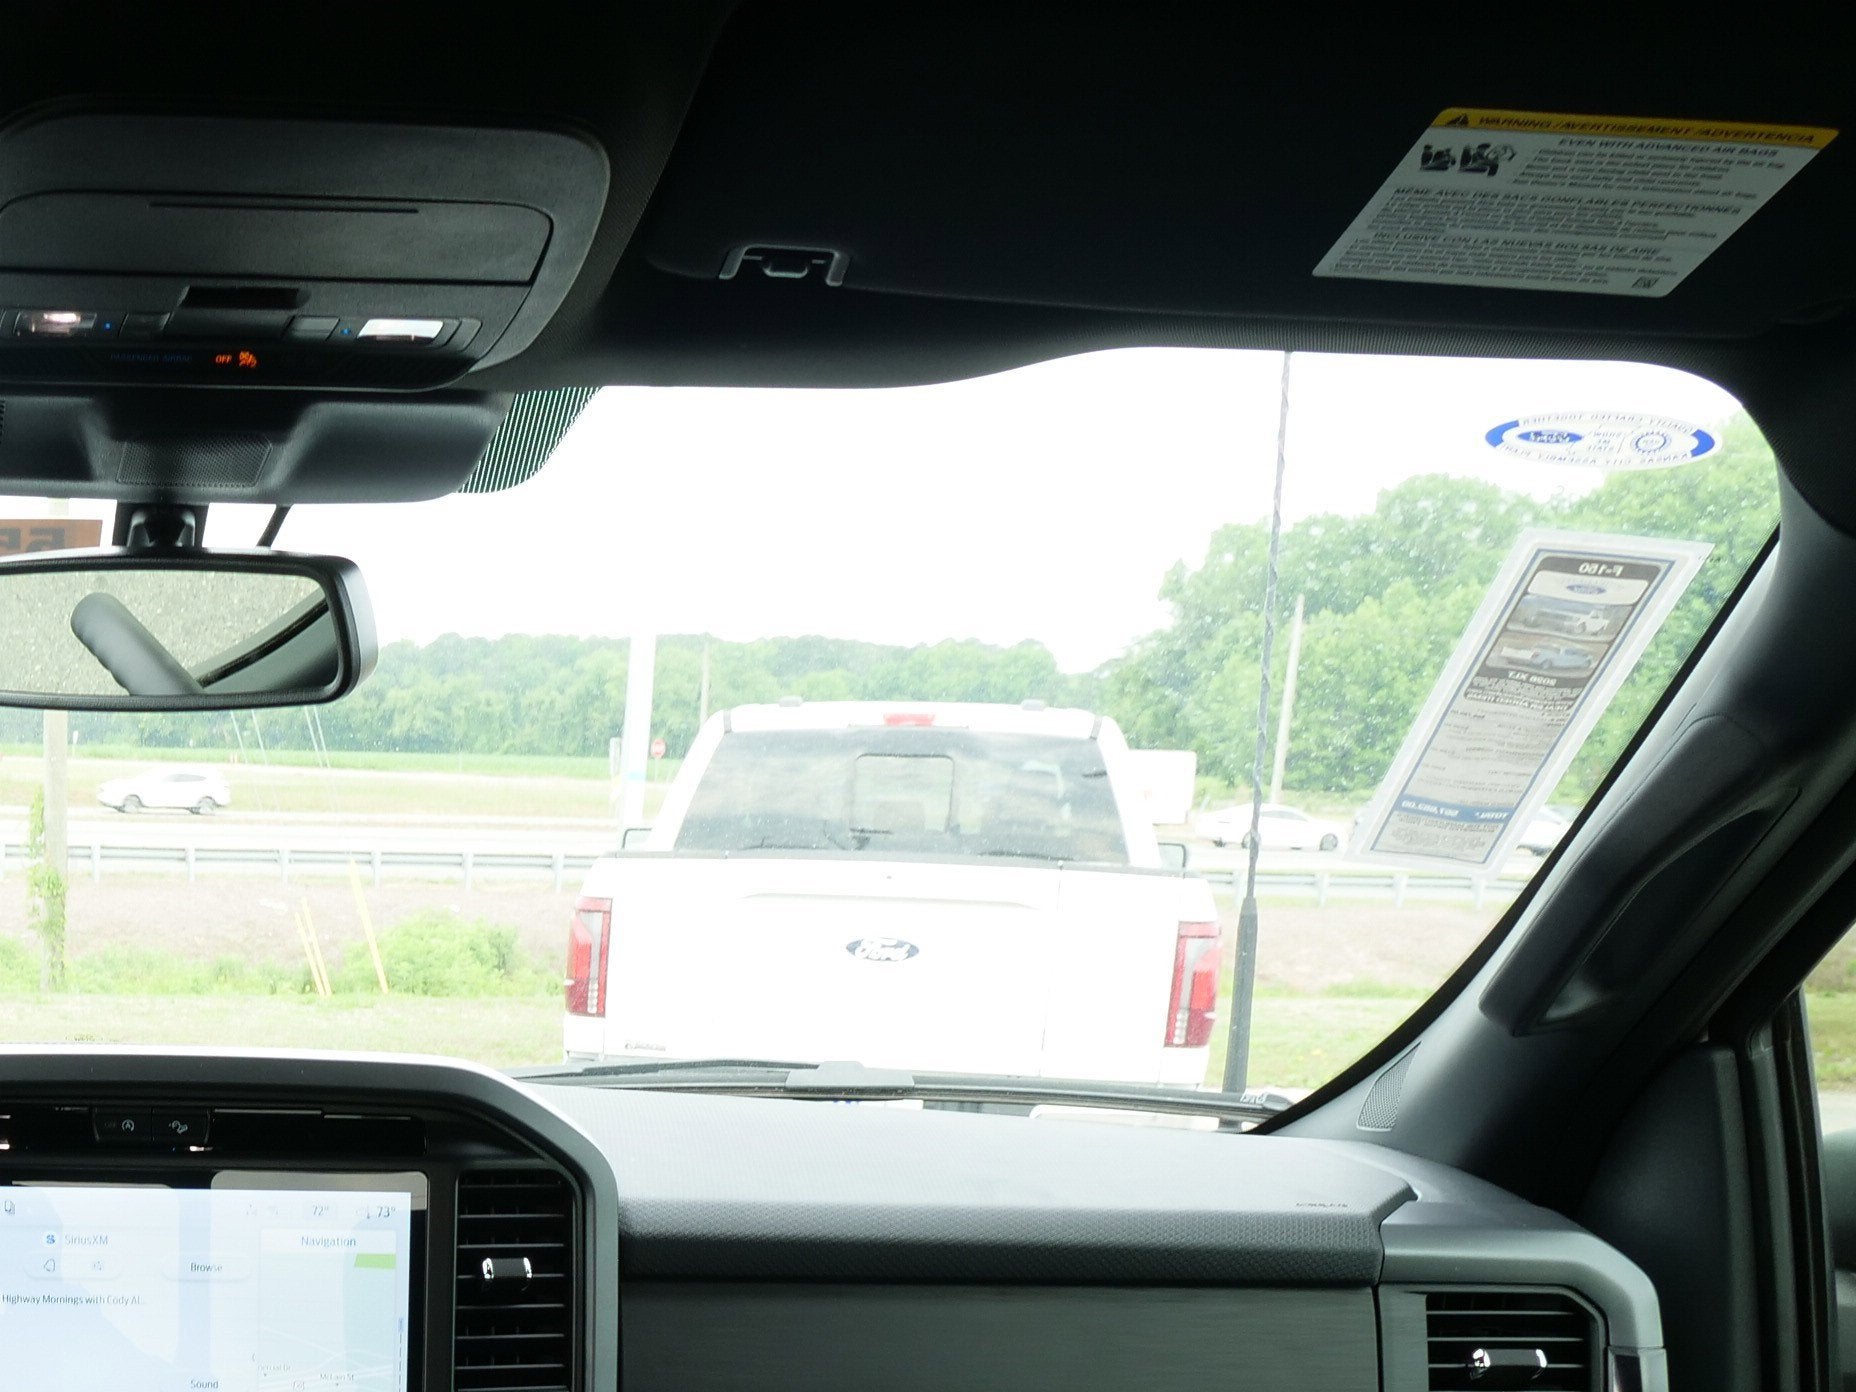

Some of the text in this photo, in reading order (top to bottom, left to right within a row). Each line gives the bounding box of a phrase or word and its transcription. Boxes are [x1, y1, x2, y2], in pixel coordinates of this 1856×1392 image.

[215, 354, 233, 363] OFF
[377, 1205, 396, 1219] 73°
[64, 1234, 109, 1246] SiriusXM
[301, 1236, 357, 1249] Navigation
[190, 1262, 223, 1272] Browse
[2, 1294, 130, 1306] Highway Mornings with Cody
[190, 1379, 219, 1389] Sound
